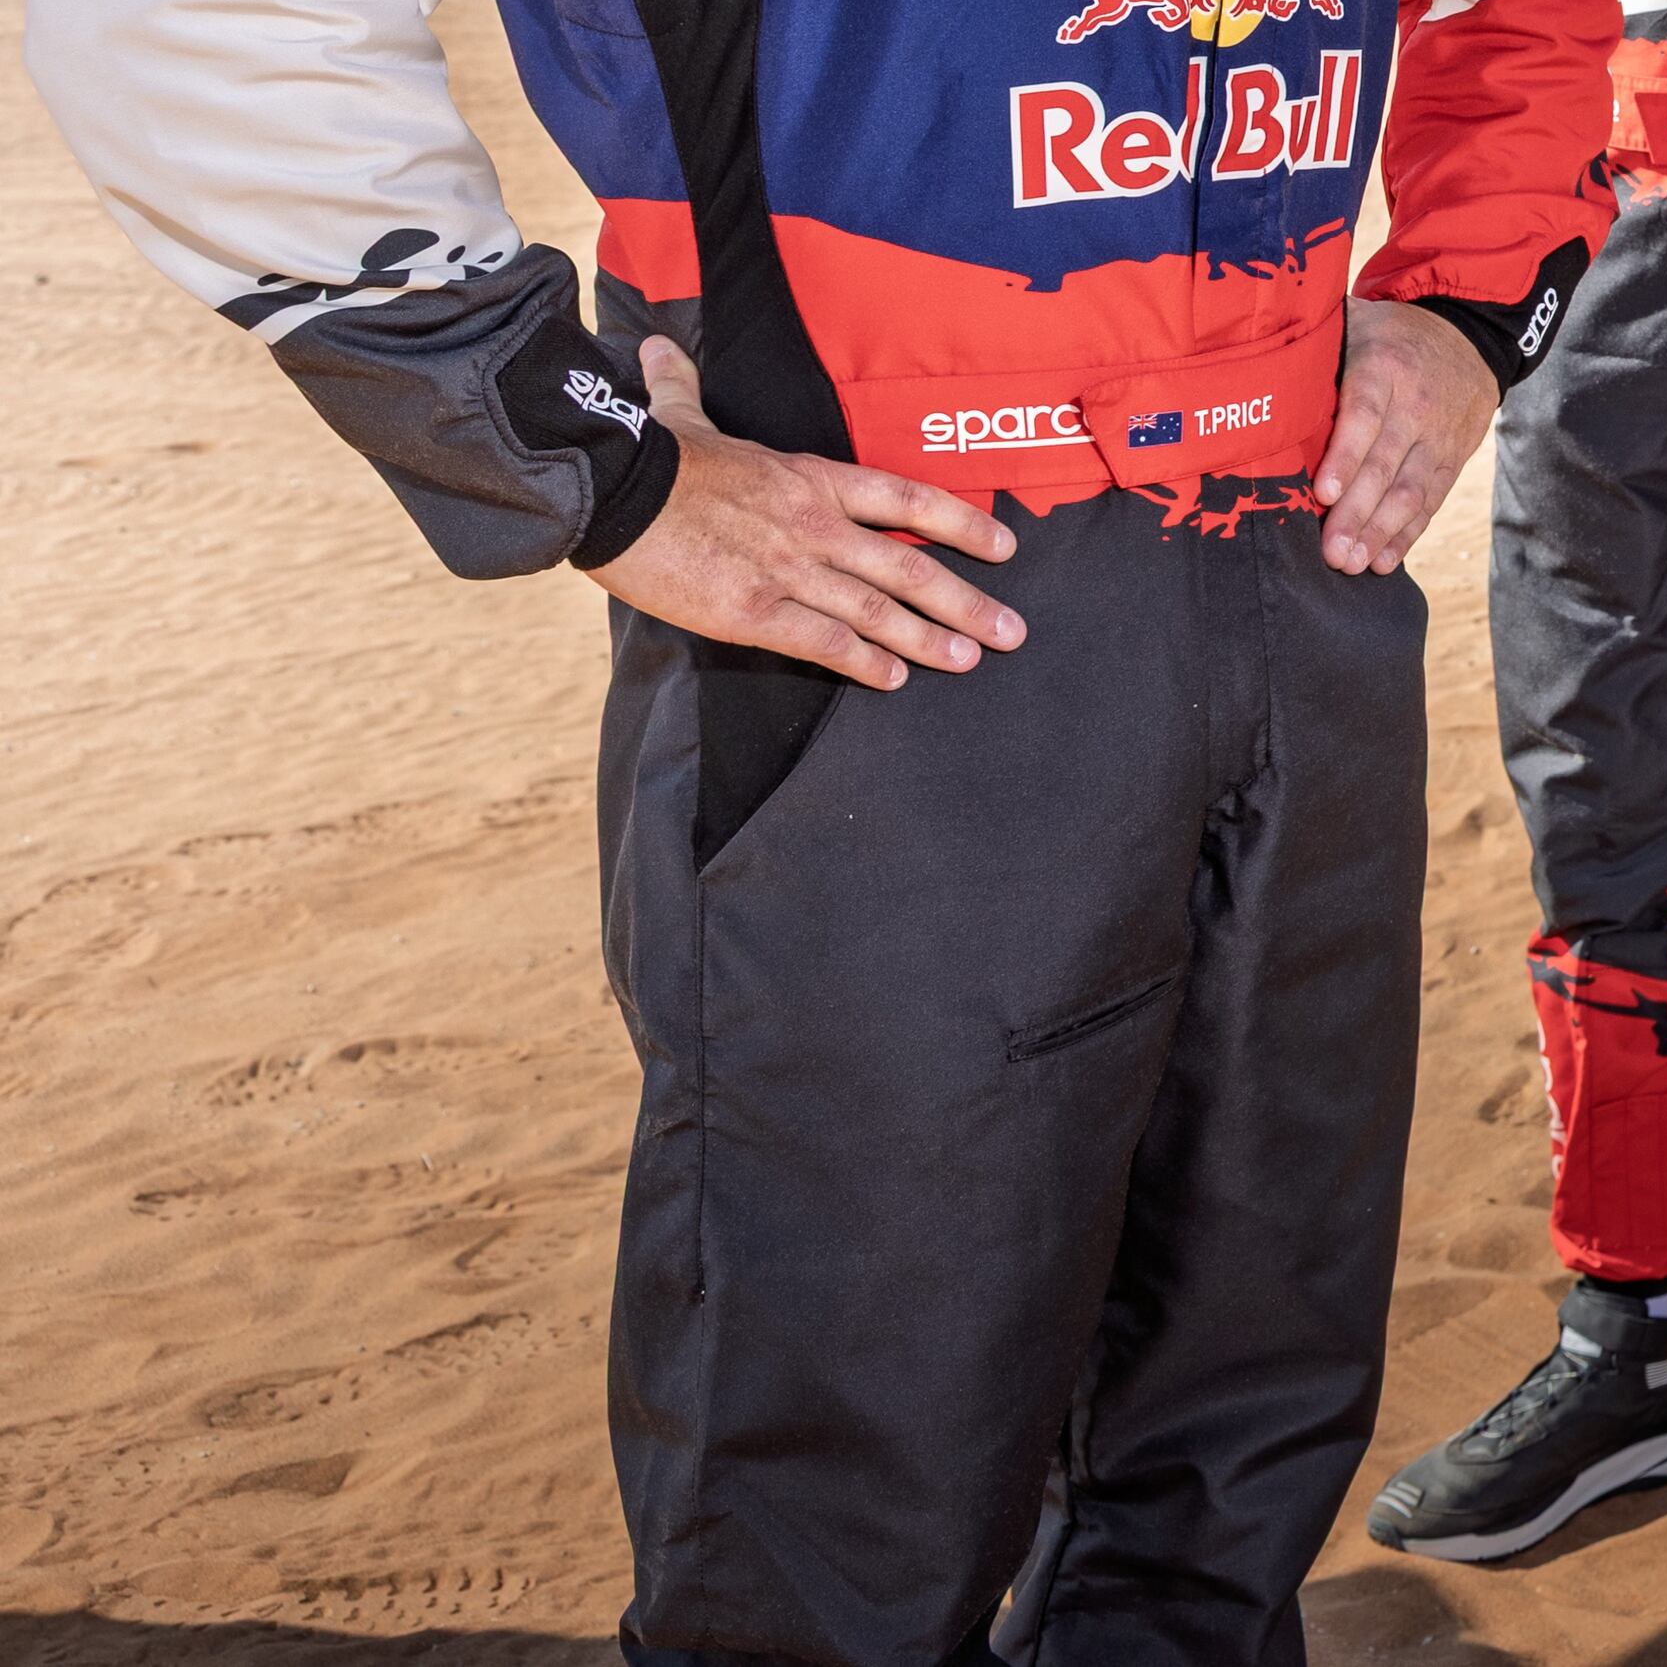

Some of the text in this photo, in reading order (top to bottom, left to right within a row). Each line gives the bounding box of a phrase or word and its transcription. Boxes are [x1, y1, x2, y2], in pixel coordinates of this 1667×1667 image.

[1212, 49, 1362, 181] Bull
[1517, 287, 1559, 357] arco
[562, 369, 648, 441] spar
[920, 403, 1090, 454] sparc
[1194, 394, 1273, 438] T.PRICE
